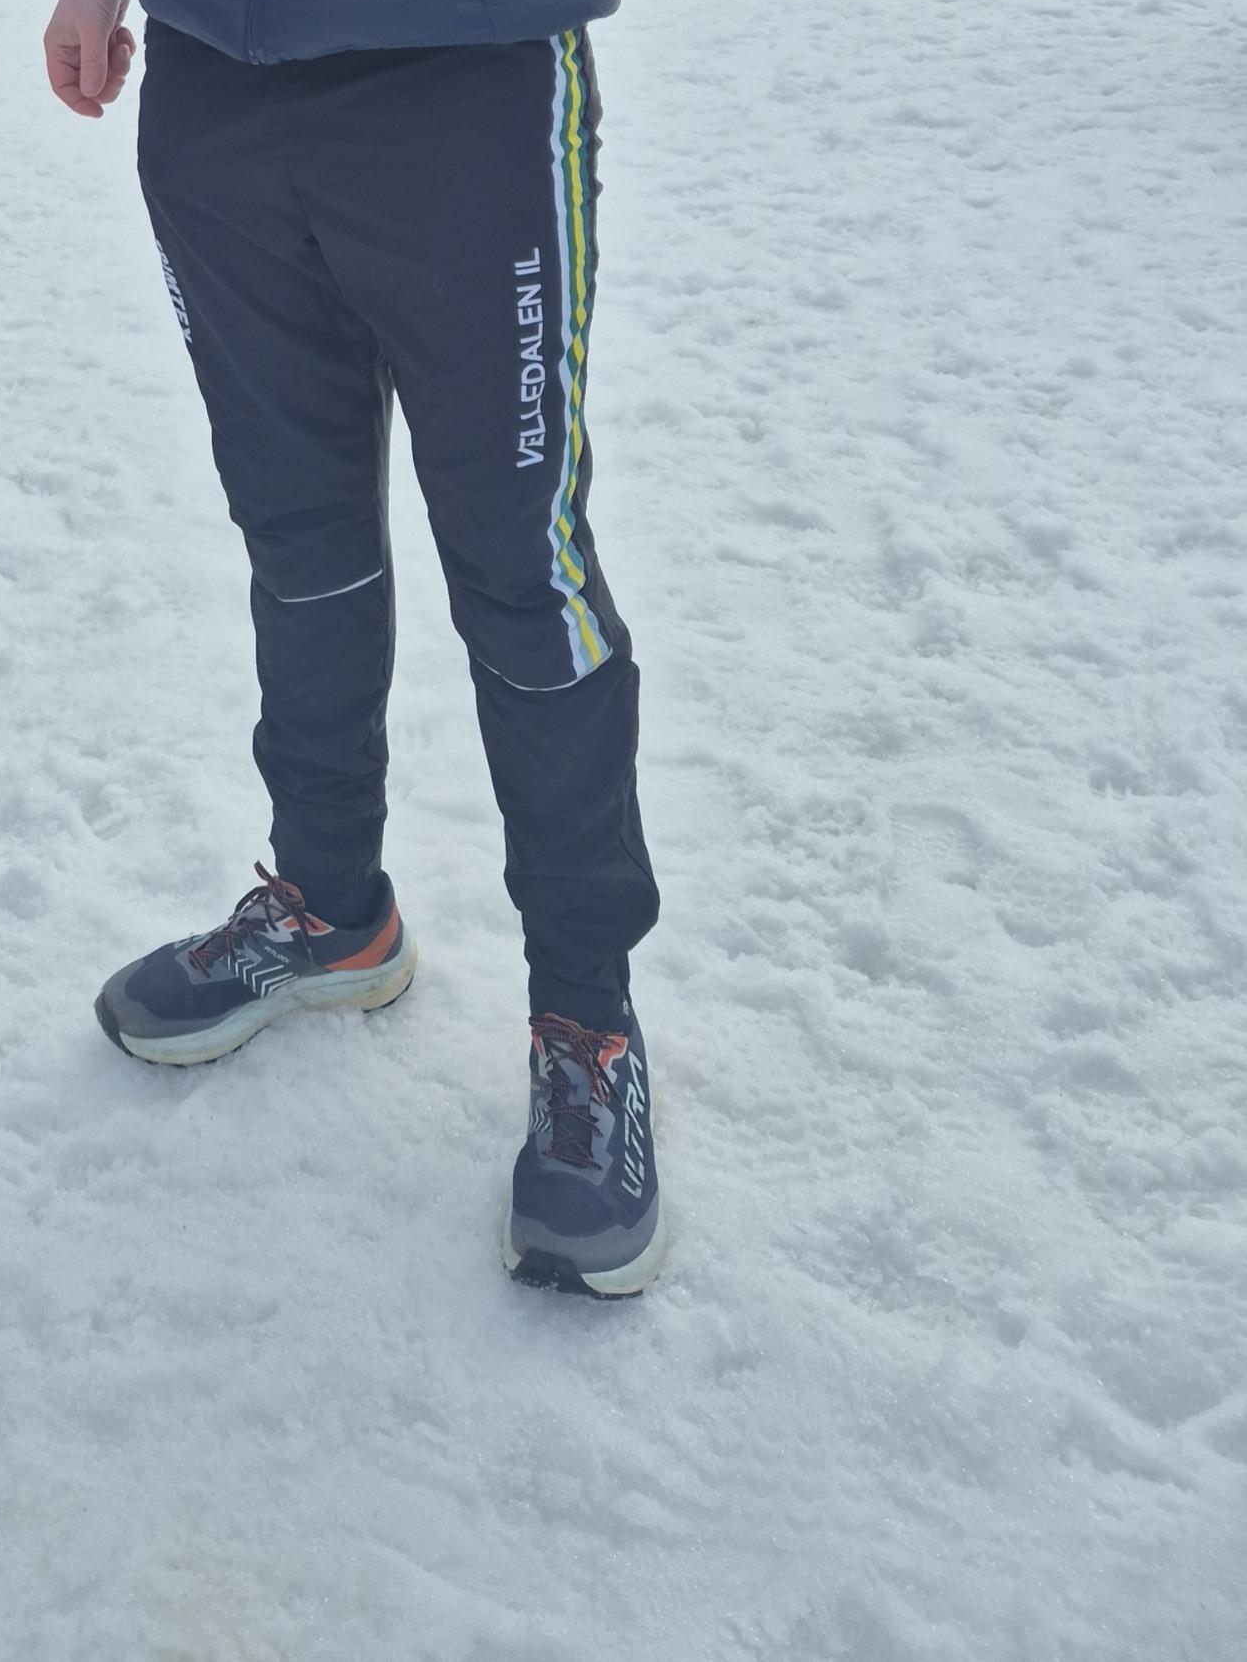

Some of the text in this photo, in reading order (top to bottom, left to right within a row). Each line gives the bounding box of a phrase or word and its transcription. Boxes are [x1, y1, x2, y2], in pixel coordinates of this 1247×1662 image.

[515, 247, 545, 469] VELLEDALEN IL
[621, 1050, 646, 1200] ULTRA
